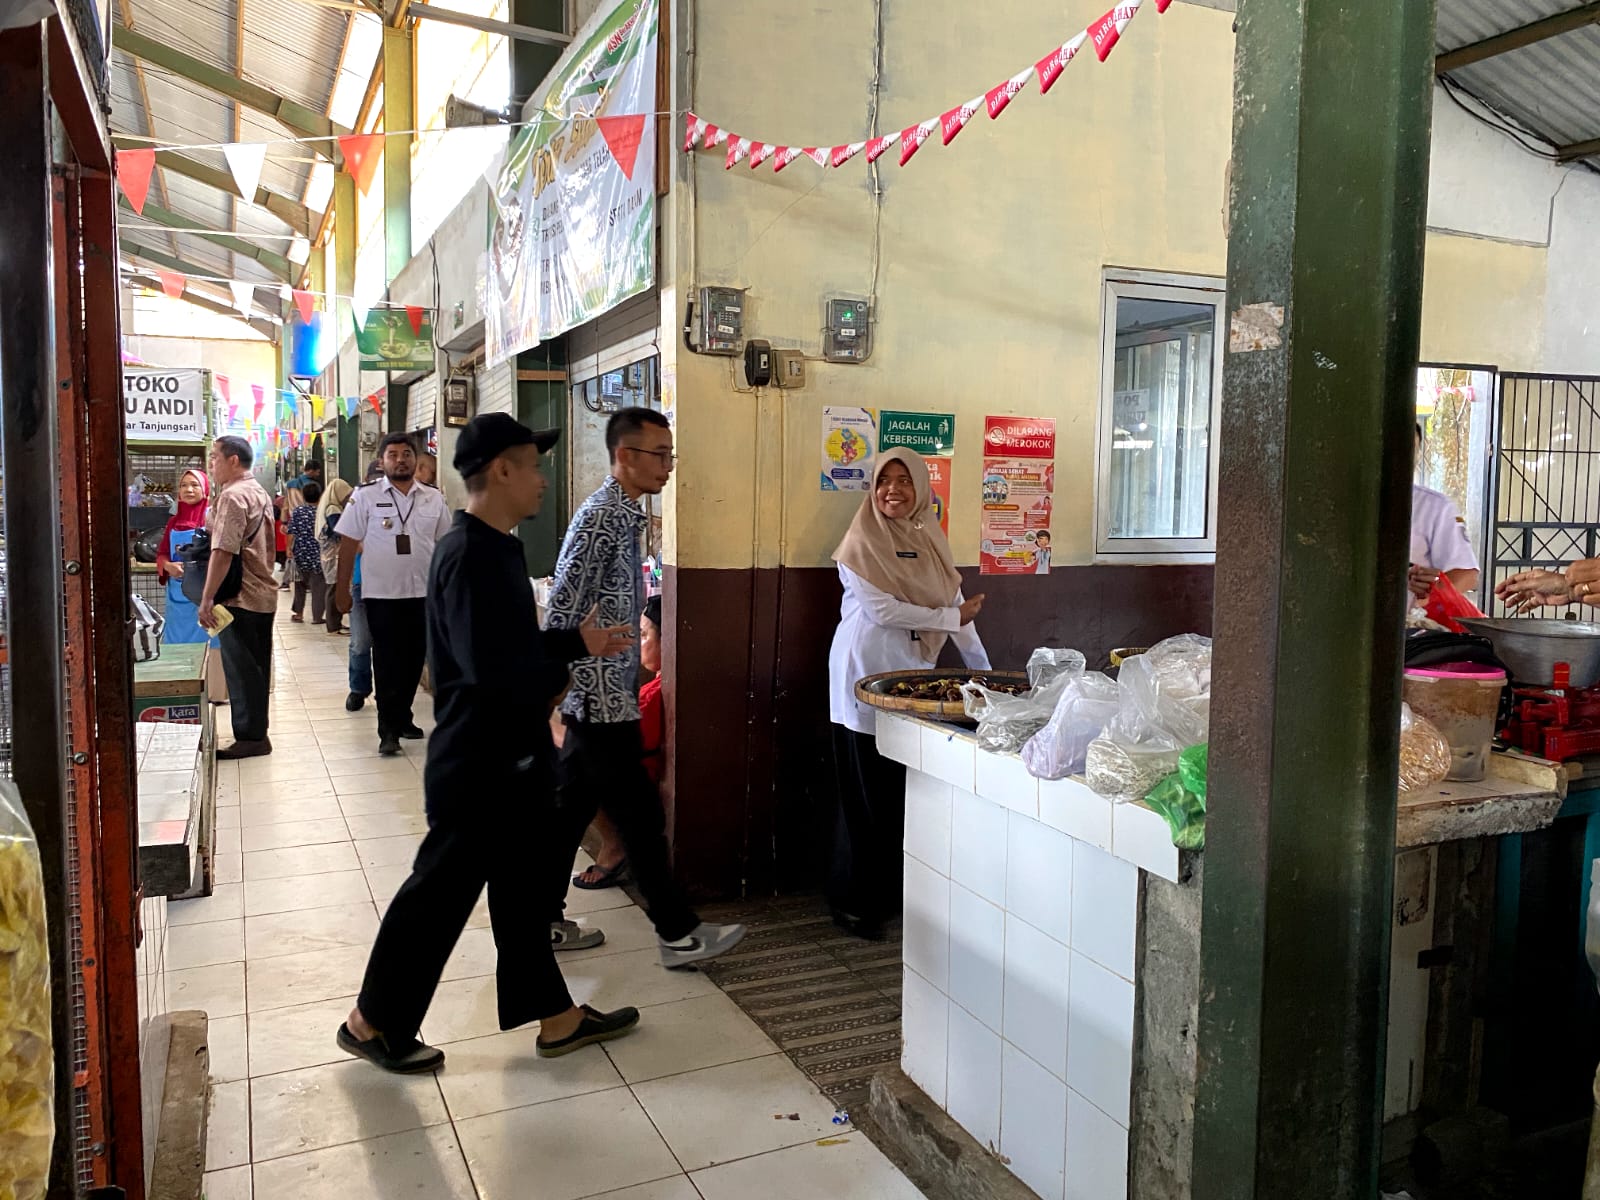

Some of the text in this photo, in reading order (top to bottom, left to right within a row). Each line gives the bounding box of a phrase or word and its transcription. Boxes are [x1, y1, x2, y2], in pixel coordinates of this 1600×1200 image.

[607, 33, 624, 54] ASN
[124, 376, 179, 393] TOKO
[125, 398, 193, 415] U ANDI
[140, 421, 196, 432] Tanjungsari
[888, 421, 931, 431] JAGALAH
[1007, 426, 1053, 437] DILARANG
[883, 434, 942, 446] KEBERSIHAN
[1006, 439, 1051, 449] MEROKOK
[171, 707, 196, 719] kara
